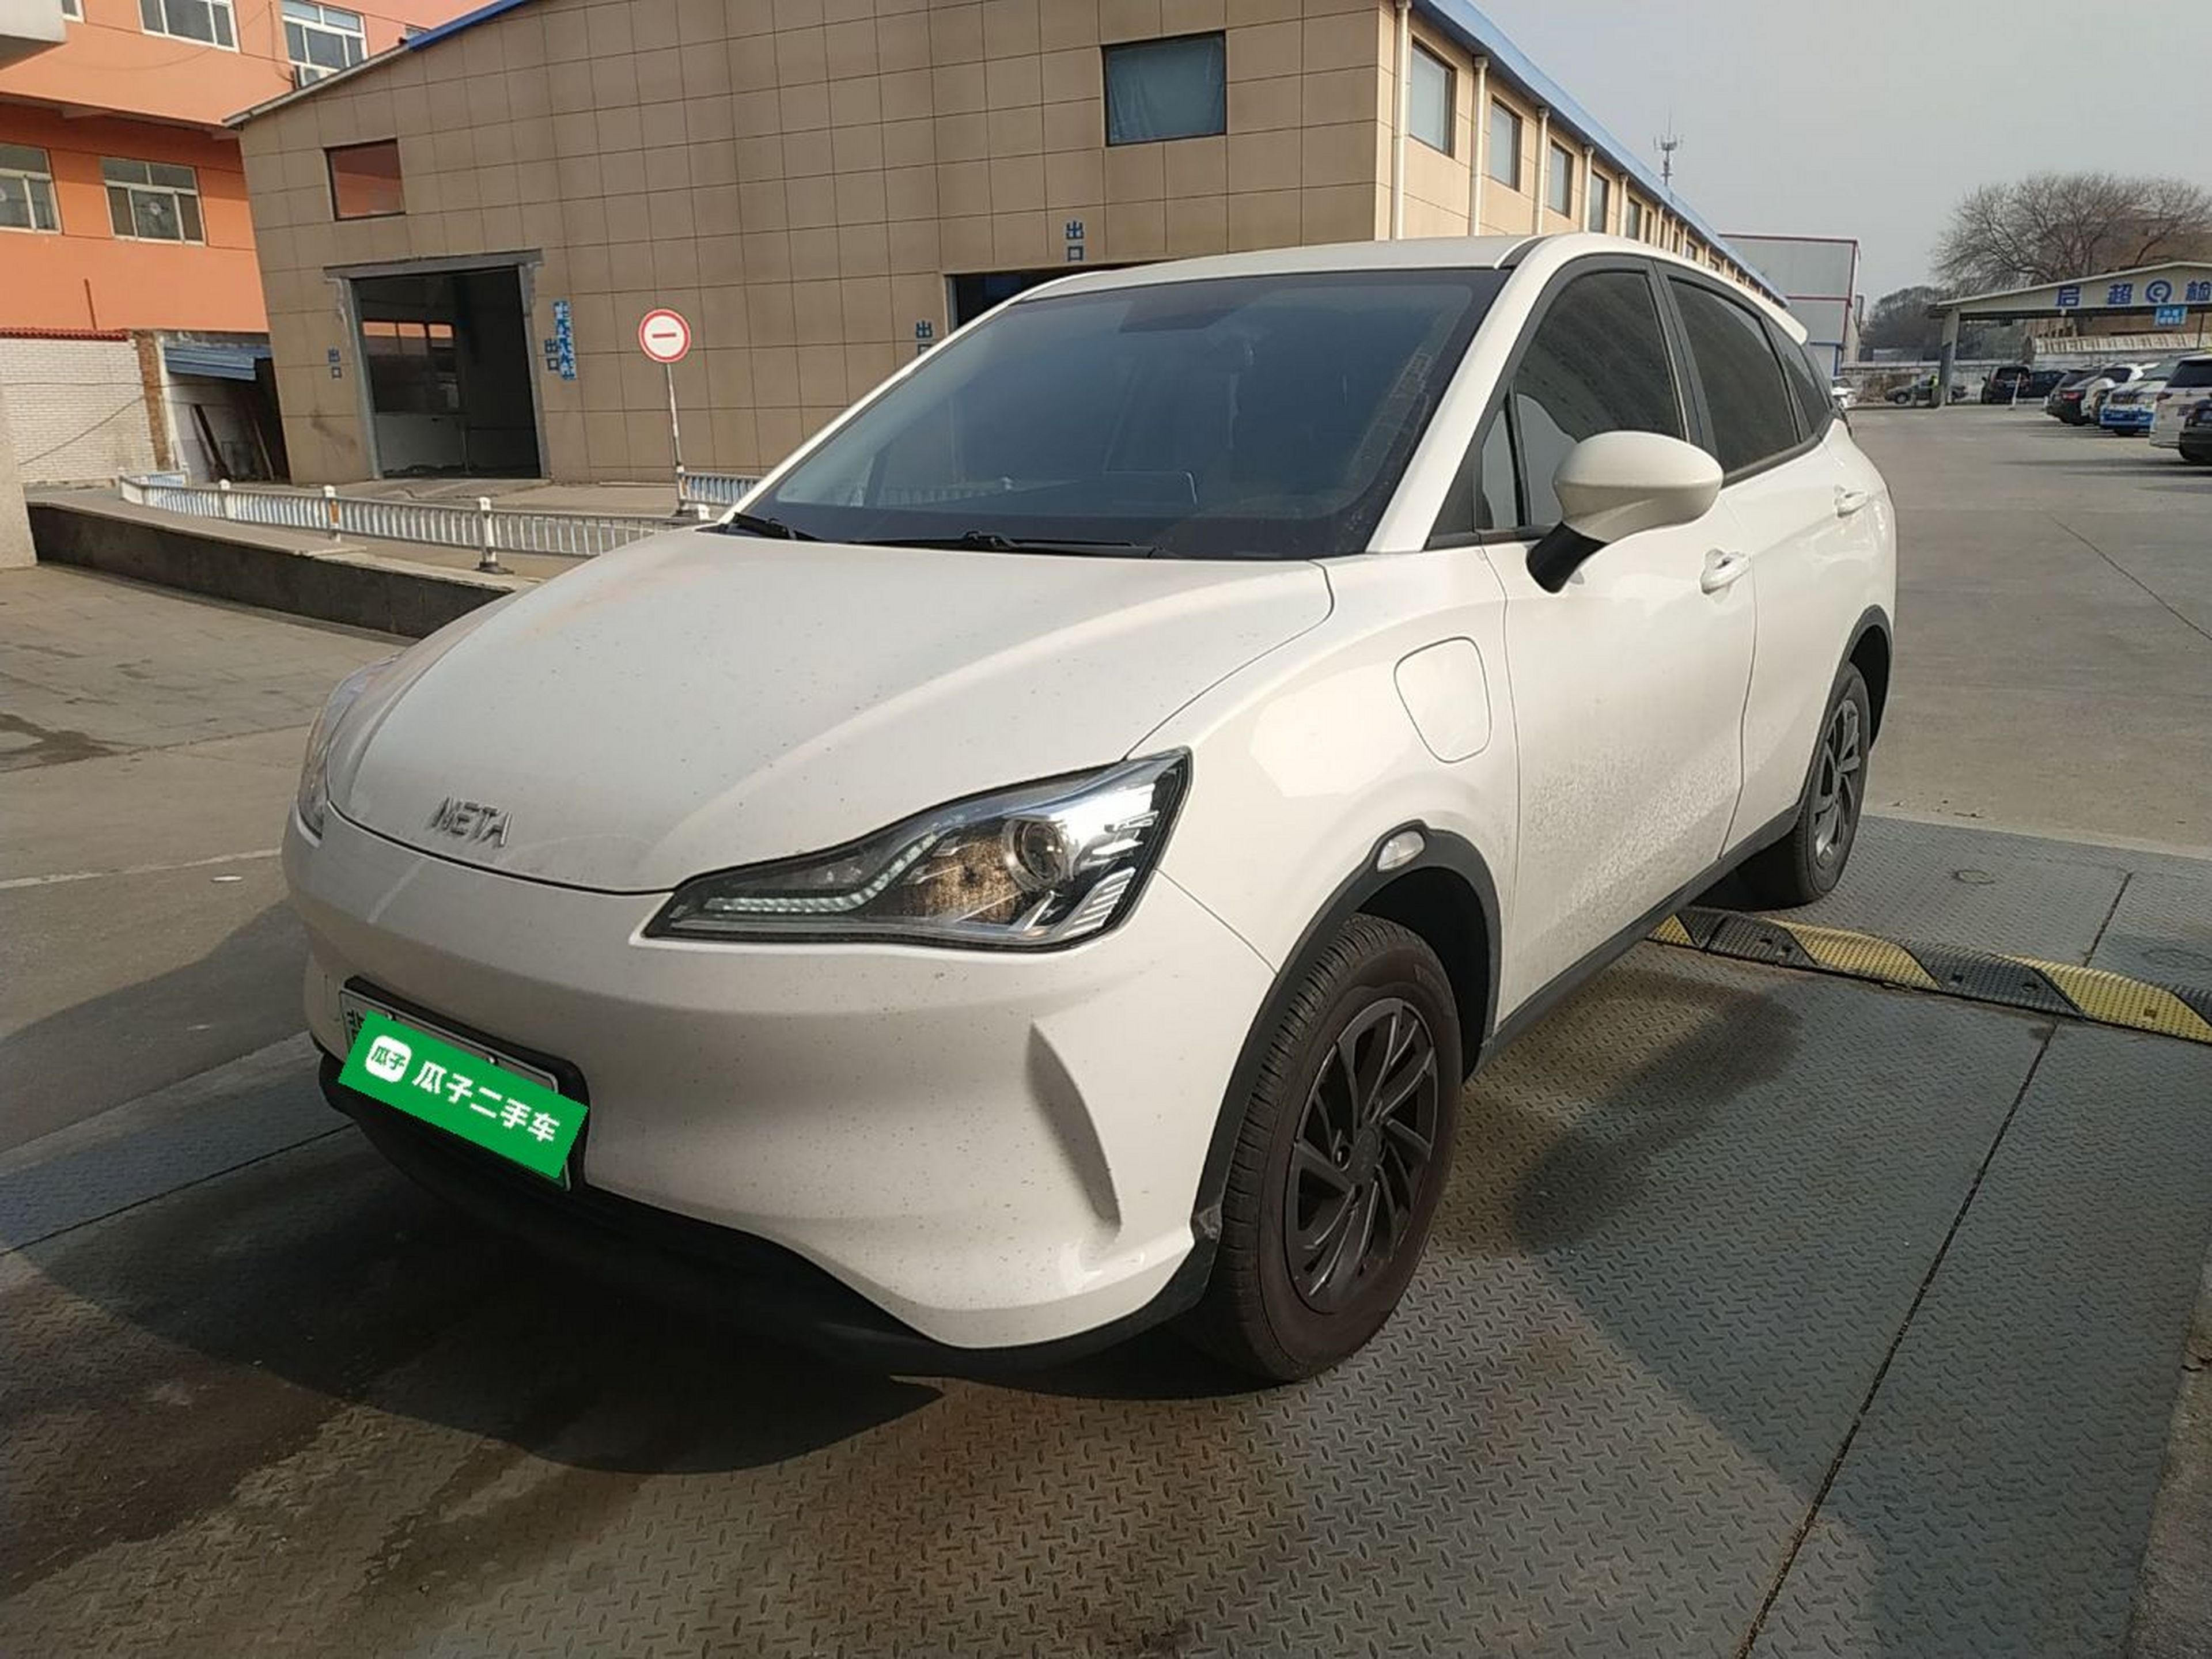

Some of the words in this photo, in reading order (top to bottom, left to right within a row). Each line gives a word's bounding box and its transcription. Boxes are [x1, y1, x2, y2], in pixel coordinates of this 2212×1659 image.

[1065, 220, 1084, 262] 出口
[328, 349, 342, 378] 出口
[544, 339, 559, 370] 出口
[431, 797, 513, 847] NETA
